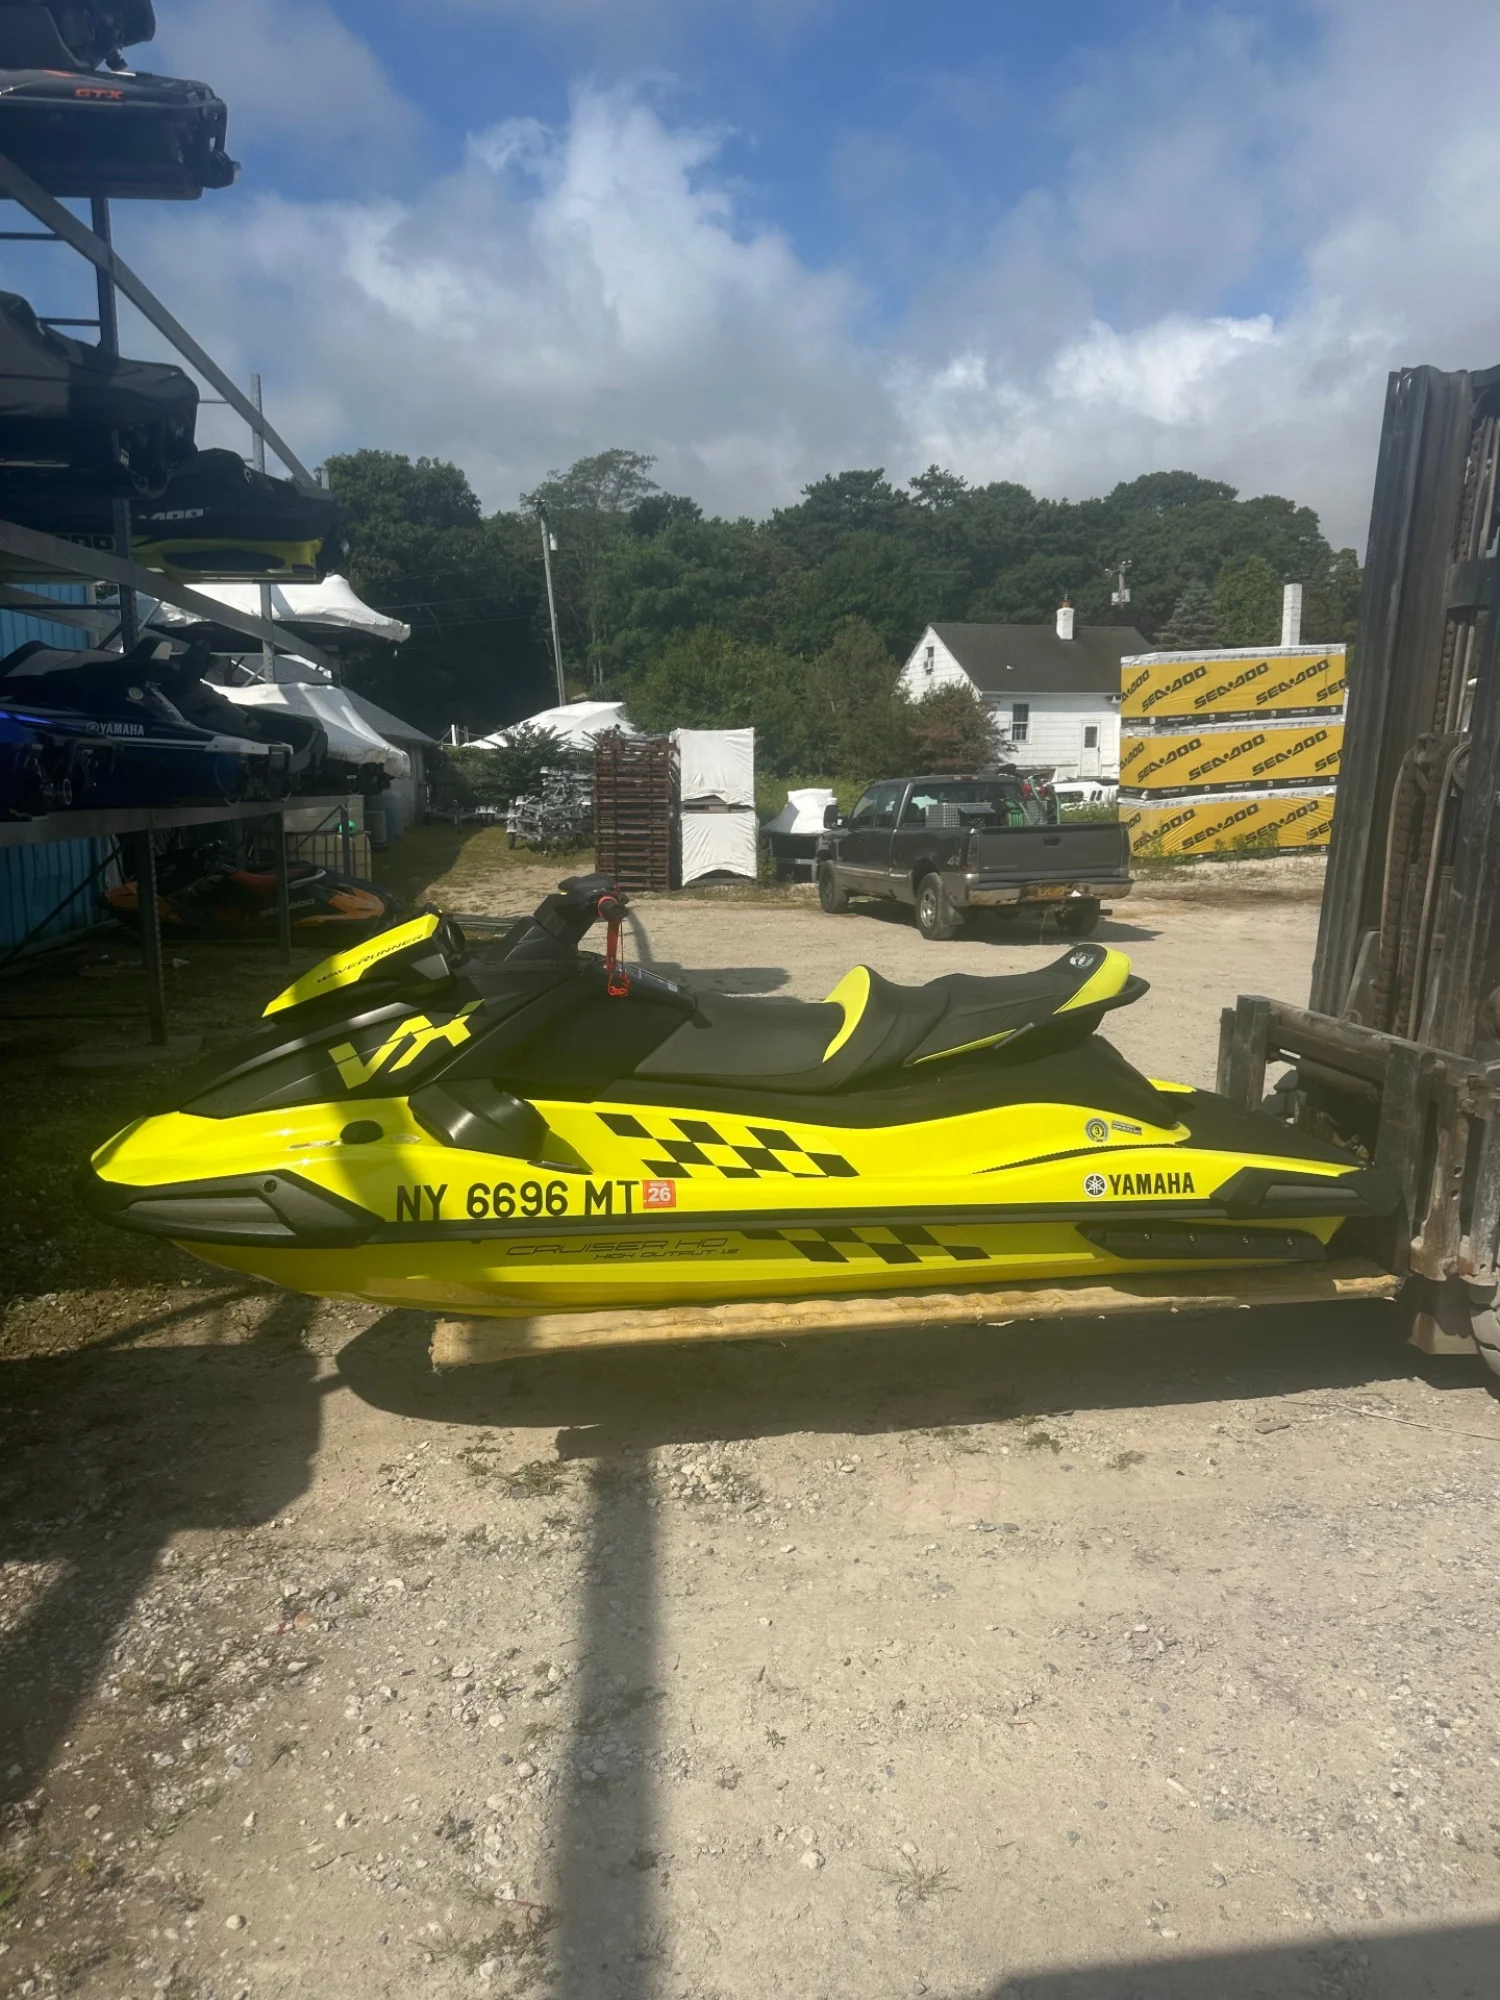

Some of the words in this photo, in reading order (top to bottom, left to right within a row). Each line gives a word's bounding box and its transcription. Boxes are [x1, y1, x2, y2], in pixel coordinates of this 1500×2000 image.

[75, 88, 123, 99] GTX
[100, 722, 145, 736] YAMAHA
[316, 933, 424, 983] WAVERUNNER
[1108, 1172, 1195, 1196] YAMAHA
[396, 1184, 448, 1222] NY
[467, 1180, 569, 1218] 6696
[585, 1180, 640, 1216] MT
[647, 1187, 671, 1202] 26
[506, 1240, 669, 1256] CRUISER
[675, 1237, 728, 1249] HO
[594, 1252, 635, 1260] HIGH
[641, 1249, 713, 1258] OUTPUT
